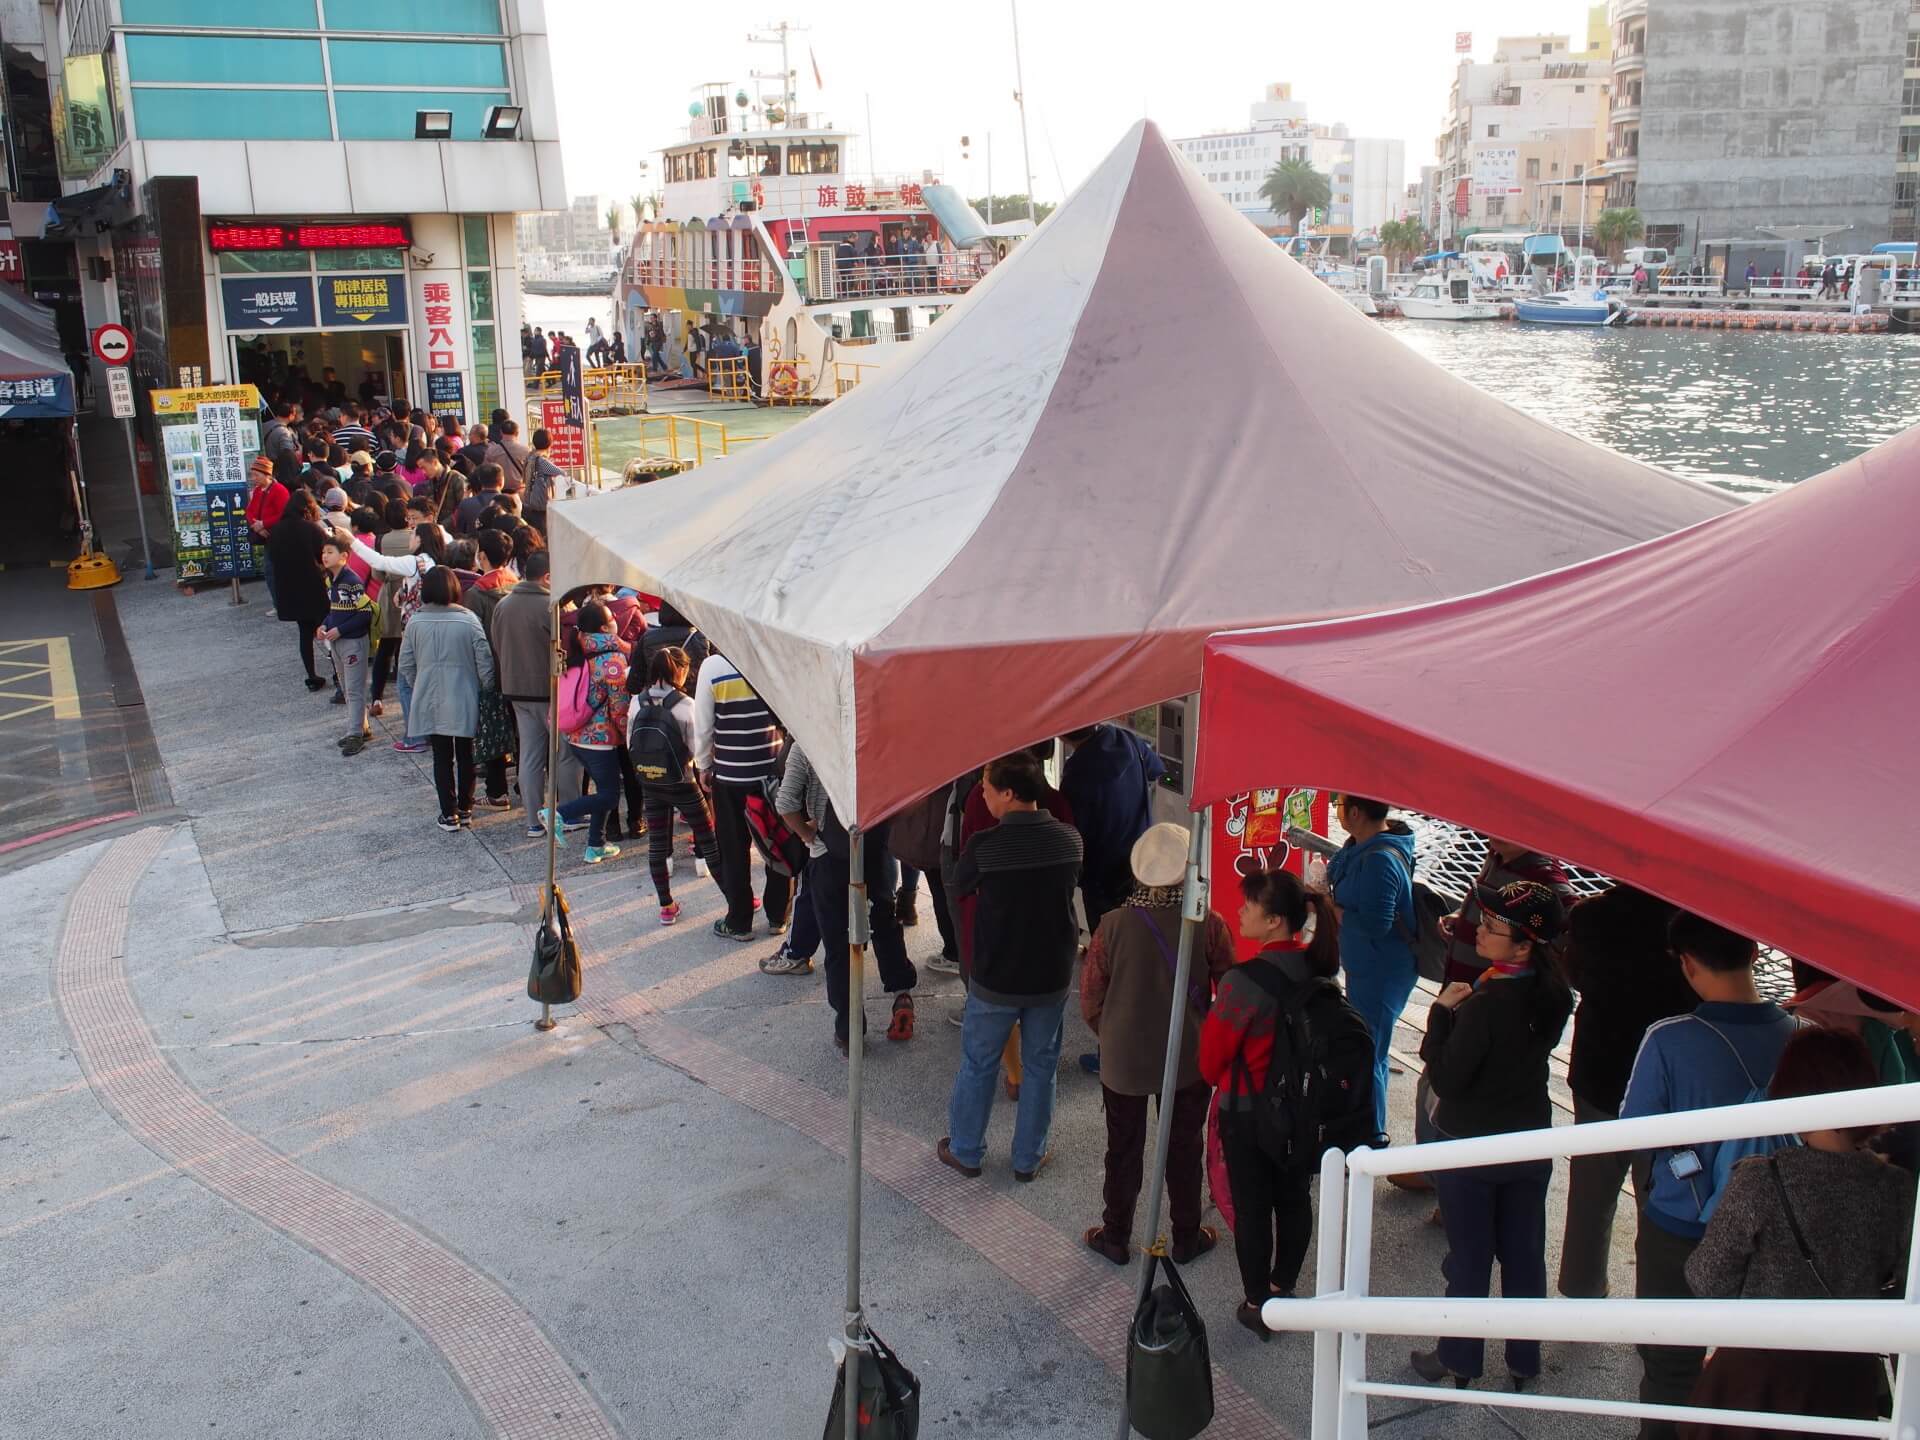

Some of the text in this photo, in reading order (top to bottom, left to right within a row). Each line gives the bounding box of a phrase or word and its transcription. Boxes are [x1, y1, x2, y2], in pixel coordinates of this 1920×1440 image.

[817, 183, 922, 207] 旗鼓一號
[333, 279, 388, 293] 旗津居民
[241, 292, 298, 306] 一般民眾
[335, 293, 389, 308] 專用通道
[424, 283, 454, 369] 乘客入口
[202, 407, 224, 481] 請先自備零錢
[220, 407, 242, 480] 歡迎搭乘渡輪
[220, 528, 229, 536] 75
[238, 527, 249, 535] 25
[240, 543, 250, 551] 20
[242, 560, 252, 568] 12
